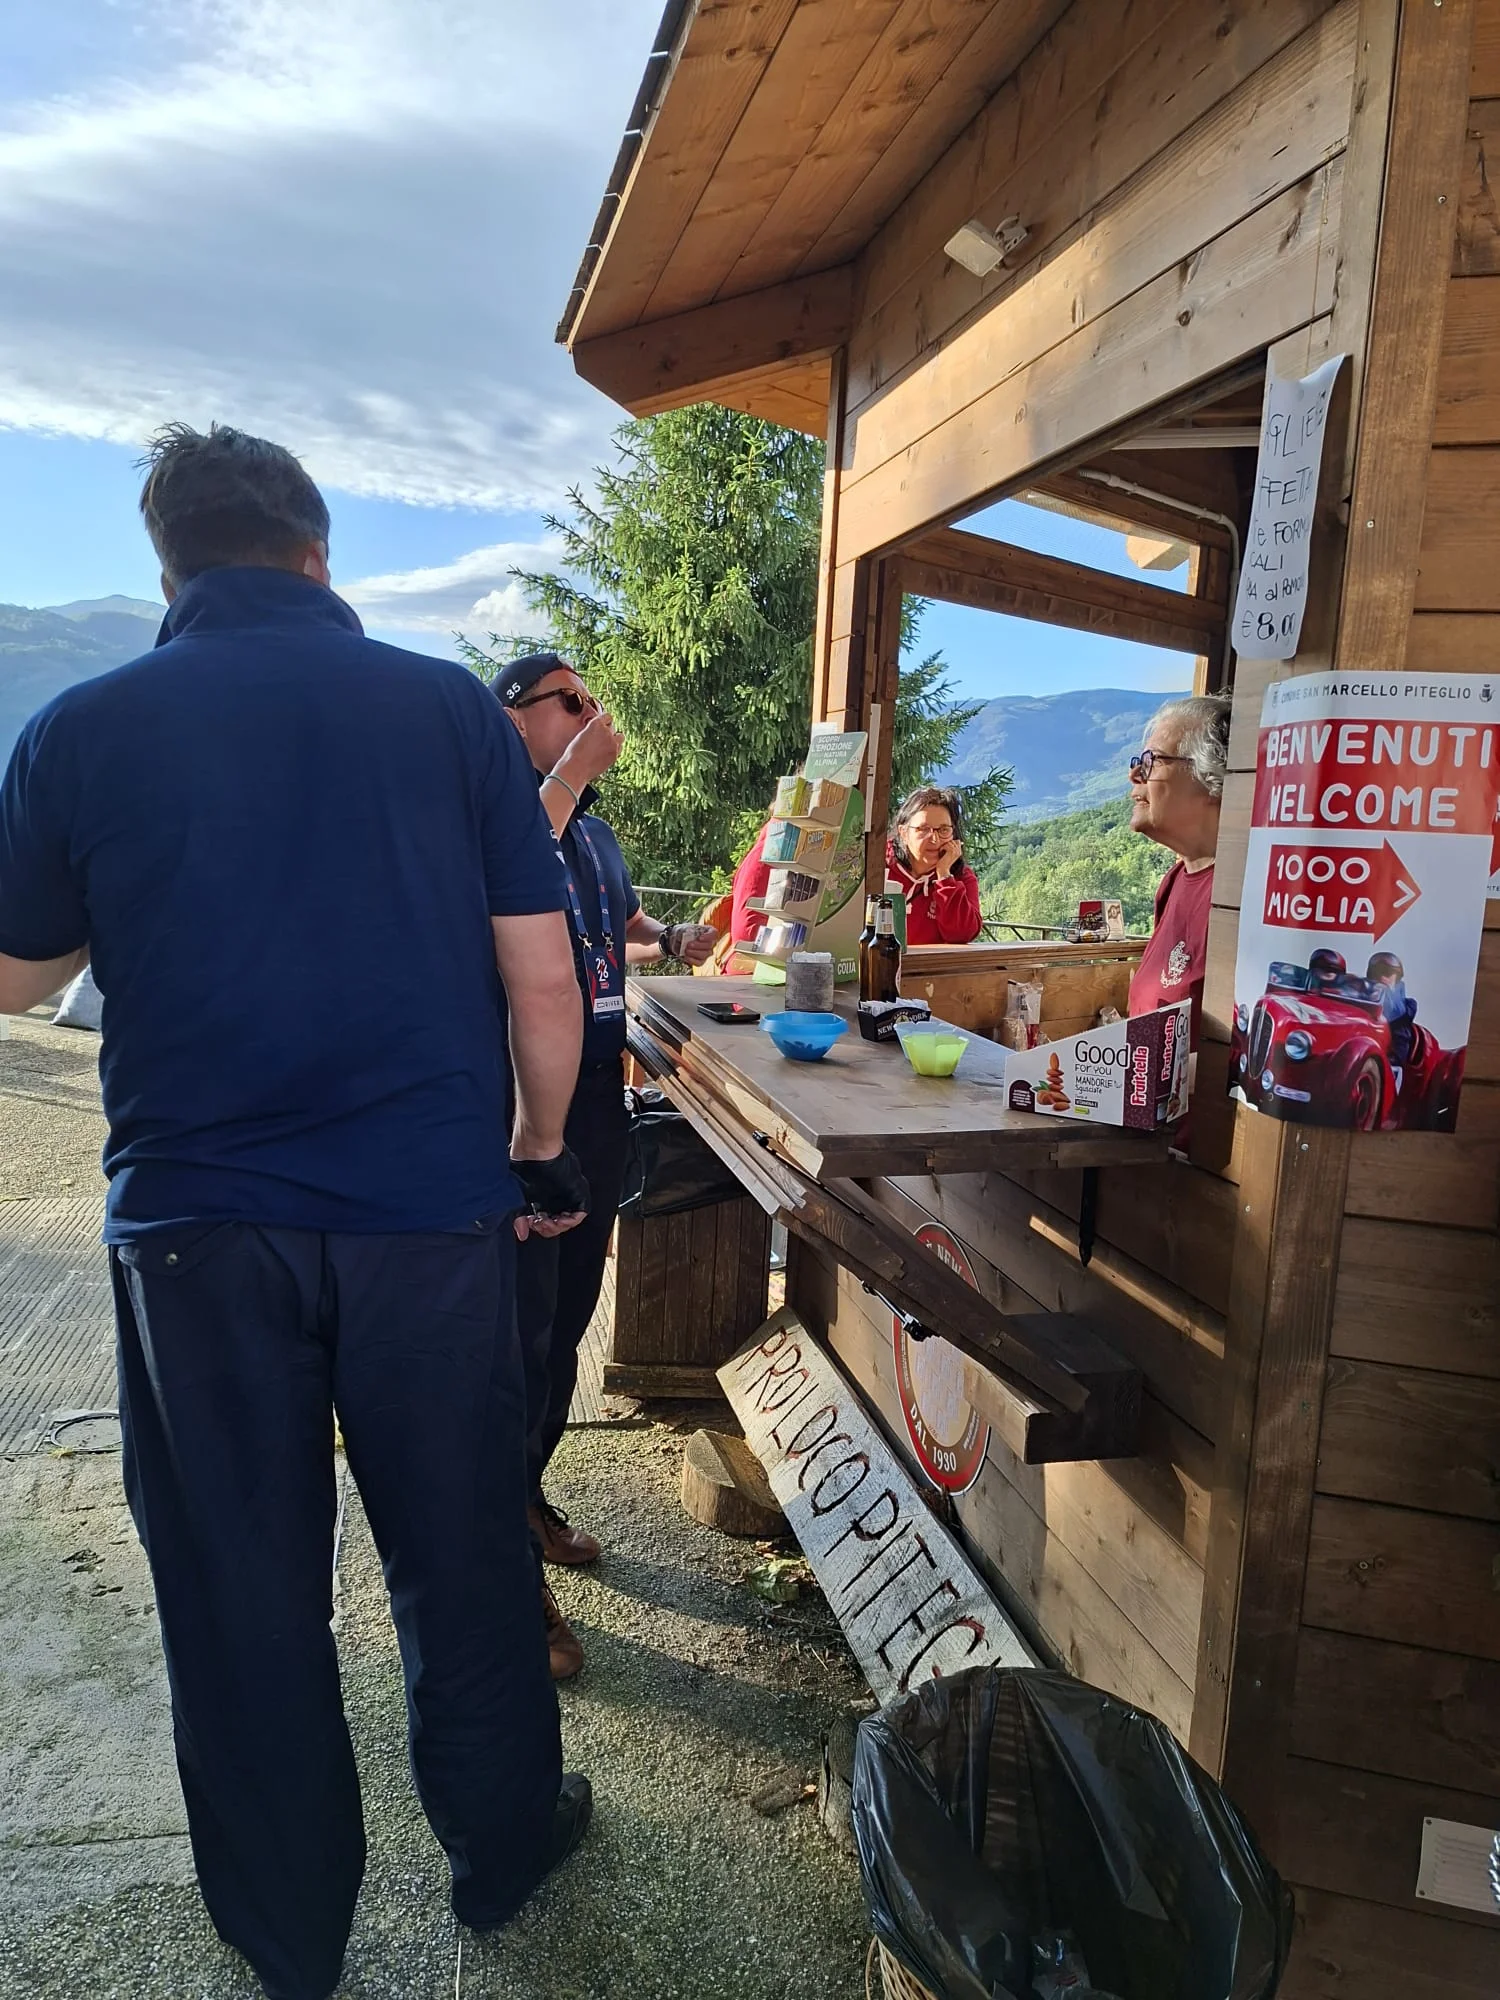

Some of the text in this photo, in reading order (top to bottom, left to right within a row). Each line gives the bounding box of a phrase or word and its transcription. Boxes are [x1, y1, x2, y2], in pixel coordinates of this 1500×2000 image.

[1302, 685, 1320, 699] SAN
[1322, 684, 1398, 698] MARCELLO
[1404, 685, 1472, 699] PITEGLIO
[1265, 723, 1493, 769] BENVENUTI
[1269, 782, 1460, 827] WELCOME
[1276, 853, 1371, 885] 1000
[1267, 891, 1376, 925] MIGLIA
[877, 1022, 893, 1036] NEW
[1075, 1040, 1129, 1068] Good
[910, 1401, 928, 1451] DAL
[931, 1446, 957, 1472] 1930
